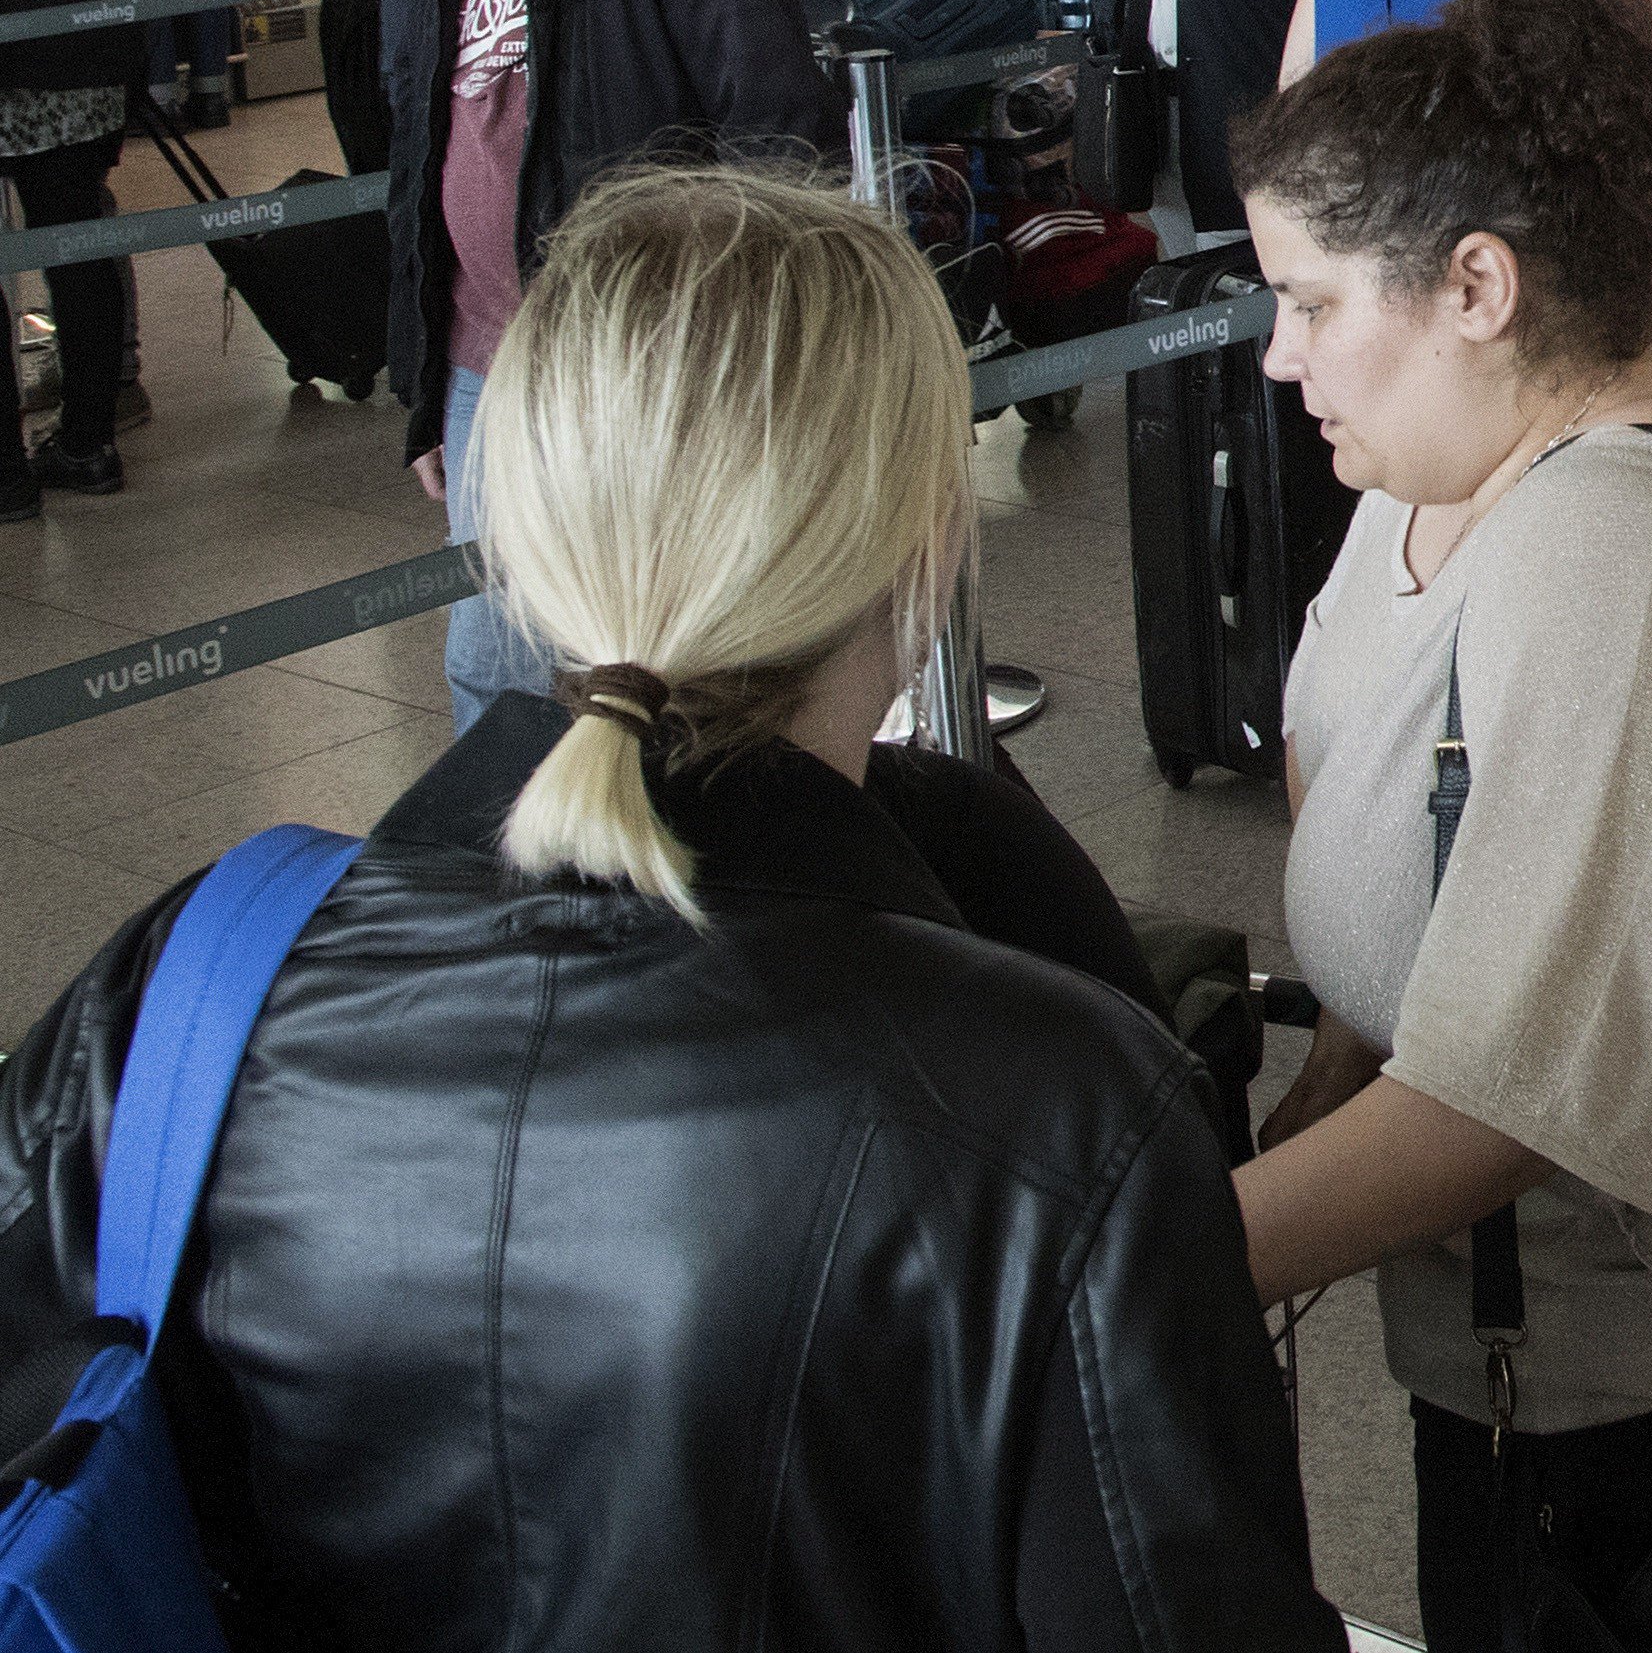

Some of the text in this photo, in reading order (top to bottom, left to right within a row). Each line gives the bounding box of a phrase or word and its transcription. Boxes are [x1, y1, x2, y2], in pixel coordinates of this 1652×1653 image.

[71, 2, 136, 25] vueling
[992, 44, 1047, 69] vueling
[201, 199, 285, 231] vueling
[1148, 314, 1229, 355] vueling
[83, 638, 222, 700] vueling
